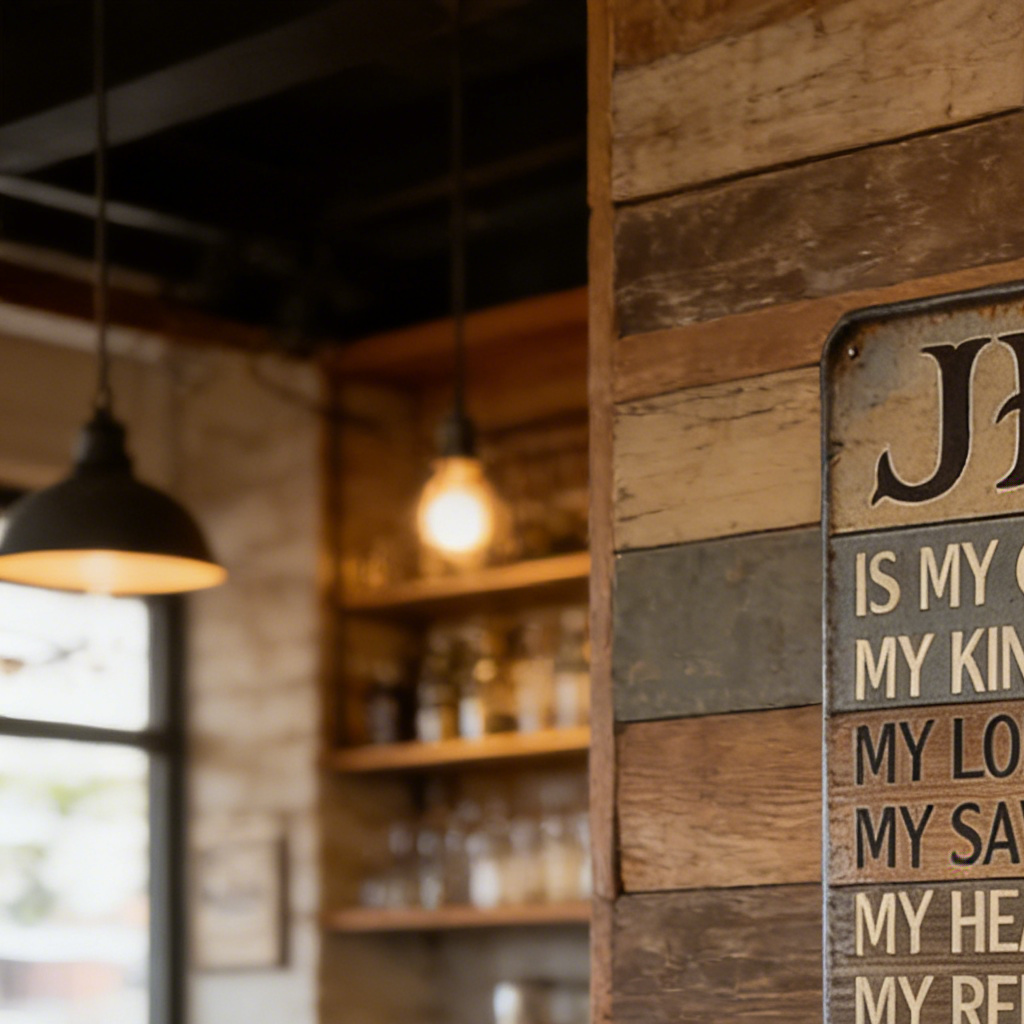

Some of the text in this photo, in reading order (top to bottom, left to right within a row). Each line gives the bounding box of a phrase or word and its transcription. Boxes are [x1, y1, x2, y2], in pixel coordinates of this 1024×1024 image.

[855, 550, 900, 617] IS
[919, 539, 998, 611] MY
[855, 633, 935, 700] MY
[856, 719, 934, 785] MY
[856, 804, 934, 869] MY
[855, 889, 934, 956] MY
